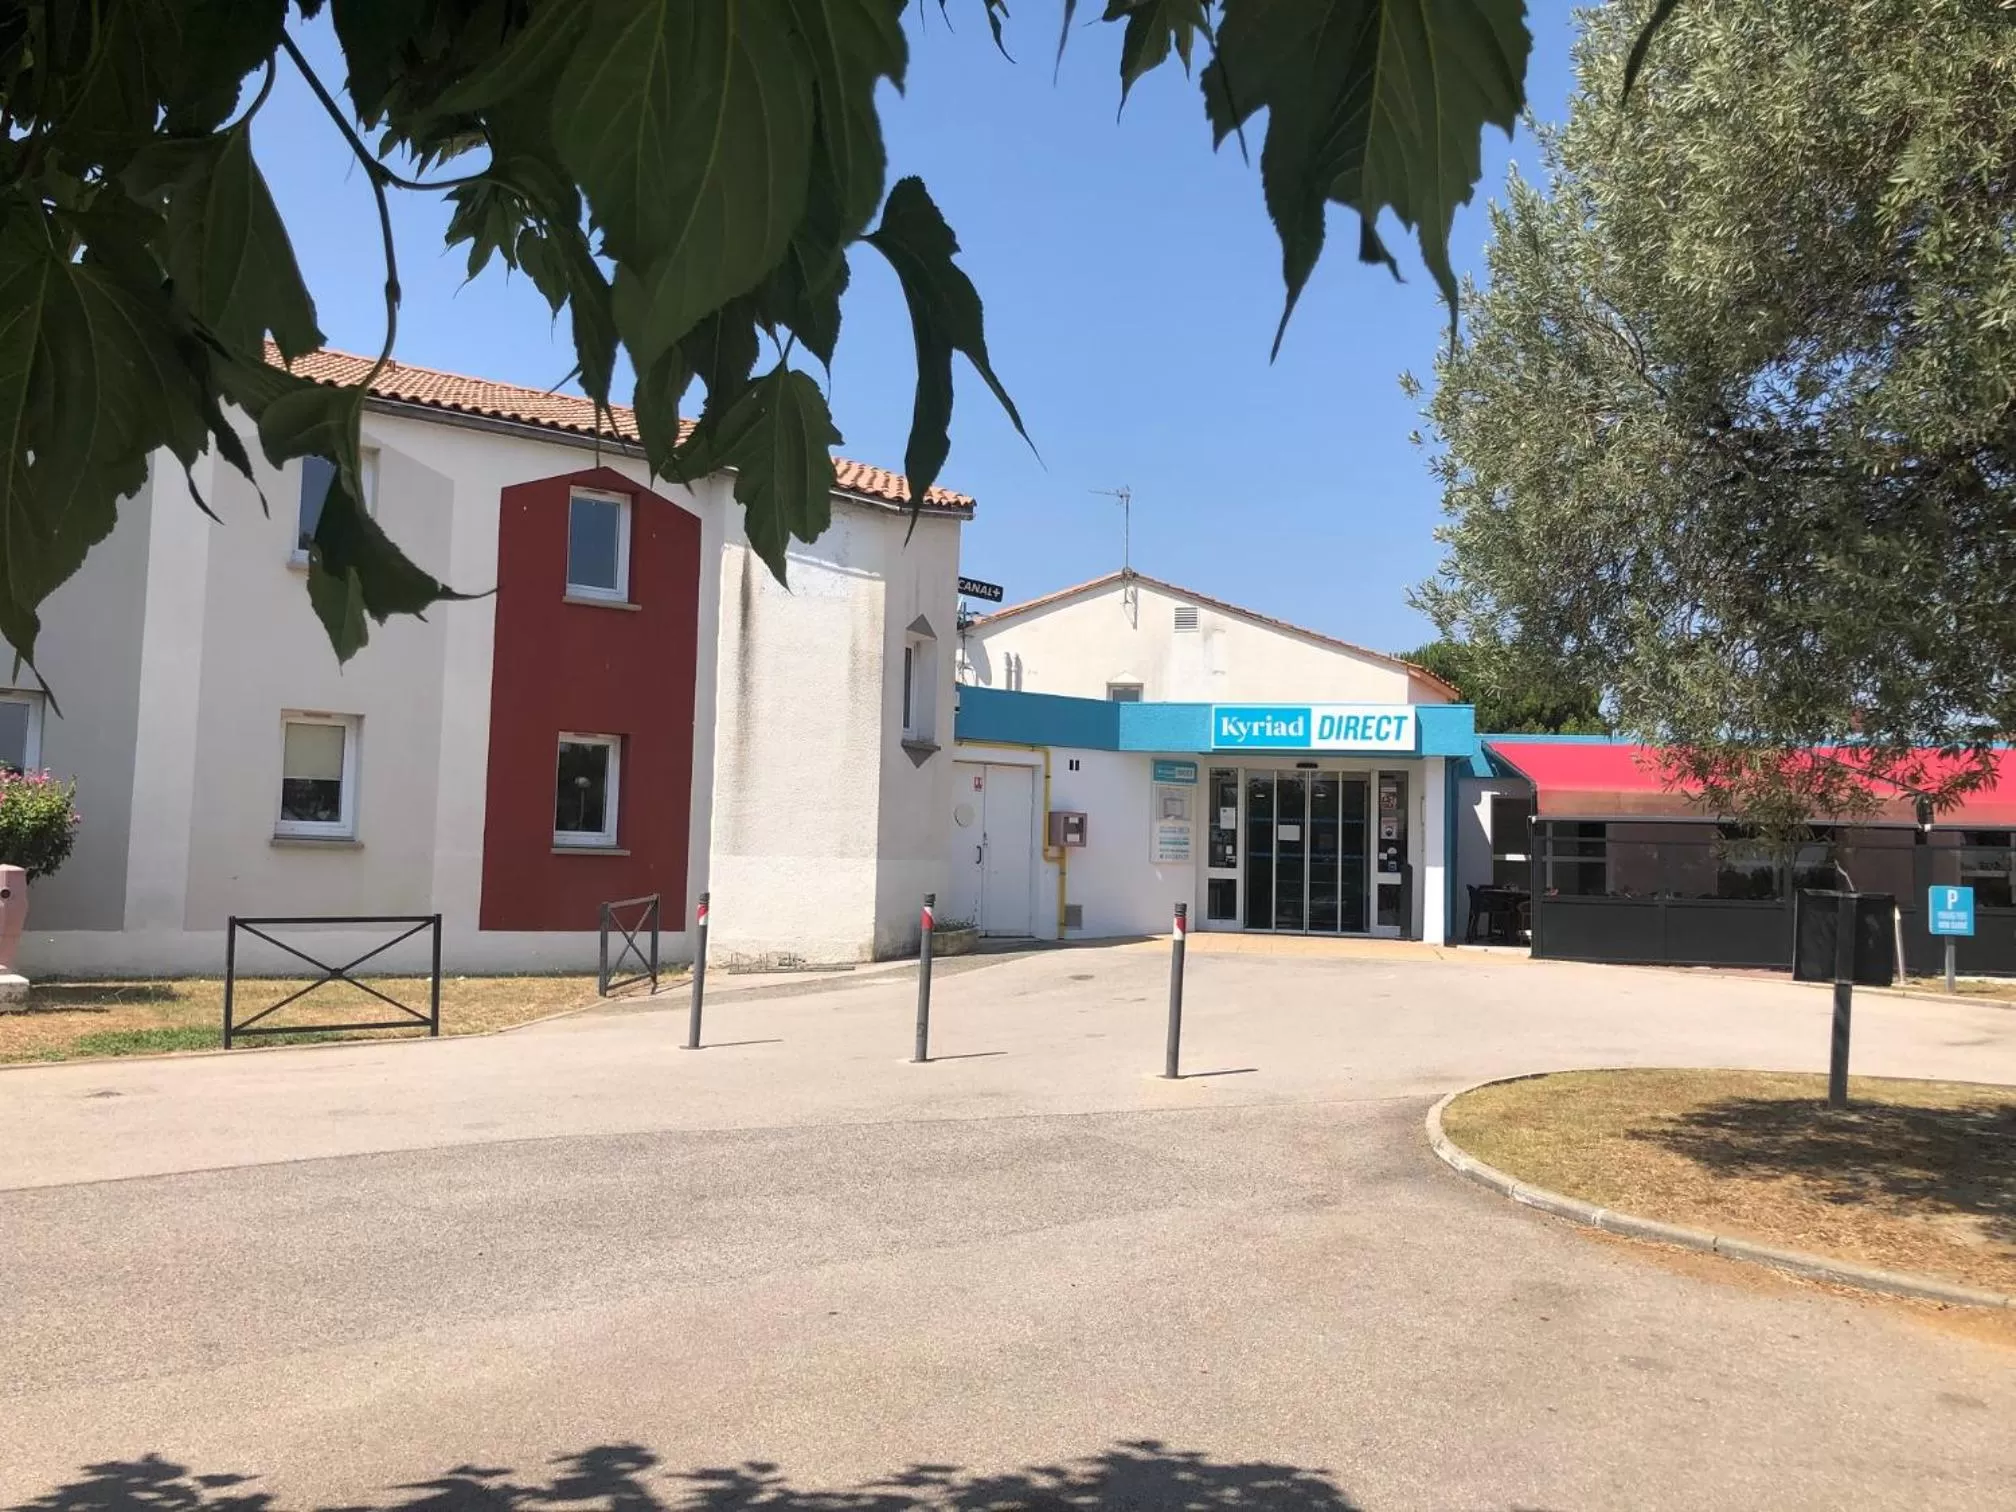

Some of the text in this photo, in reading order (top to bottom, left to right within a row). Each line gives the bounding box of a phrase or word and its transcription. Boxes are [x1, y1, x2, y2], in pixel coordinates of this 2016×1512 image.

[1221, 715, 1408, 743] Kyriad DIRECT
[1947, 889, 1958, 910] P
